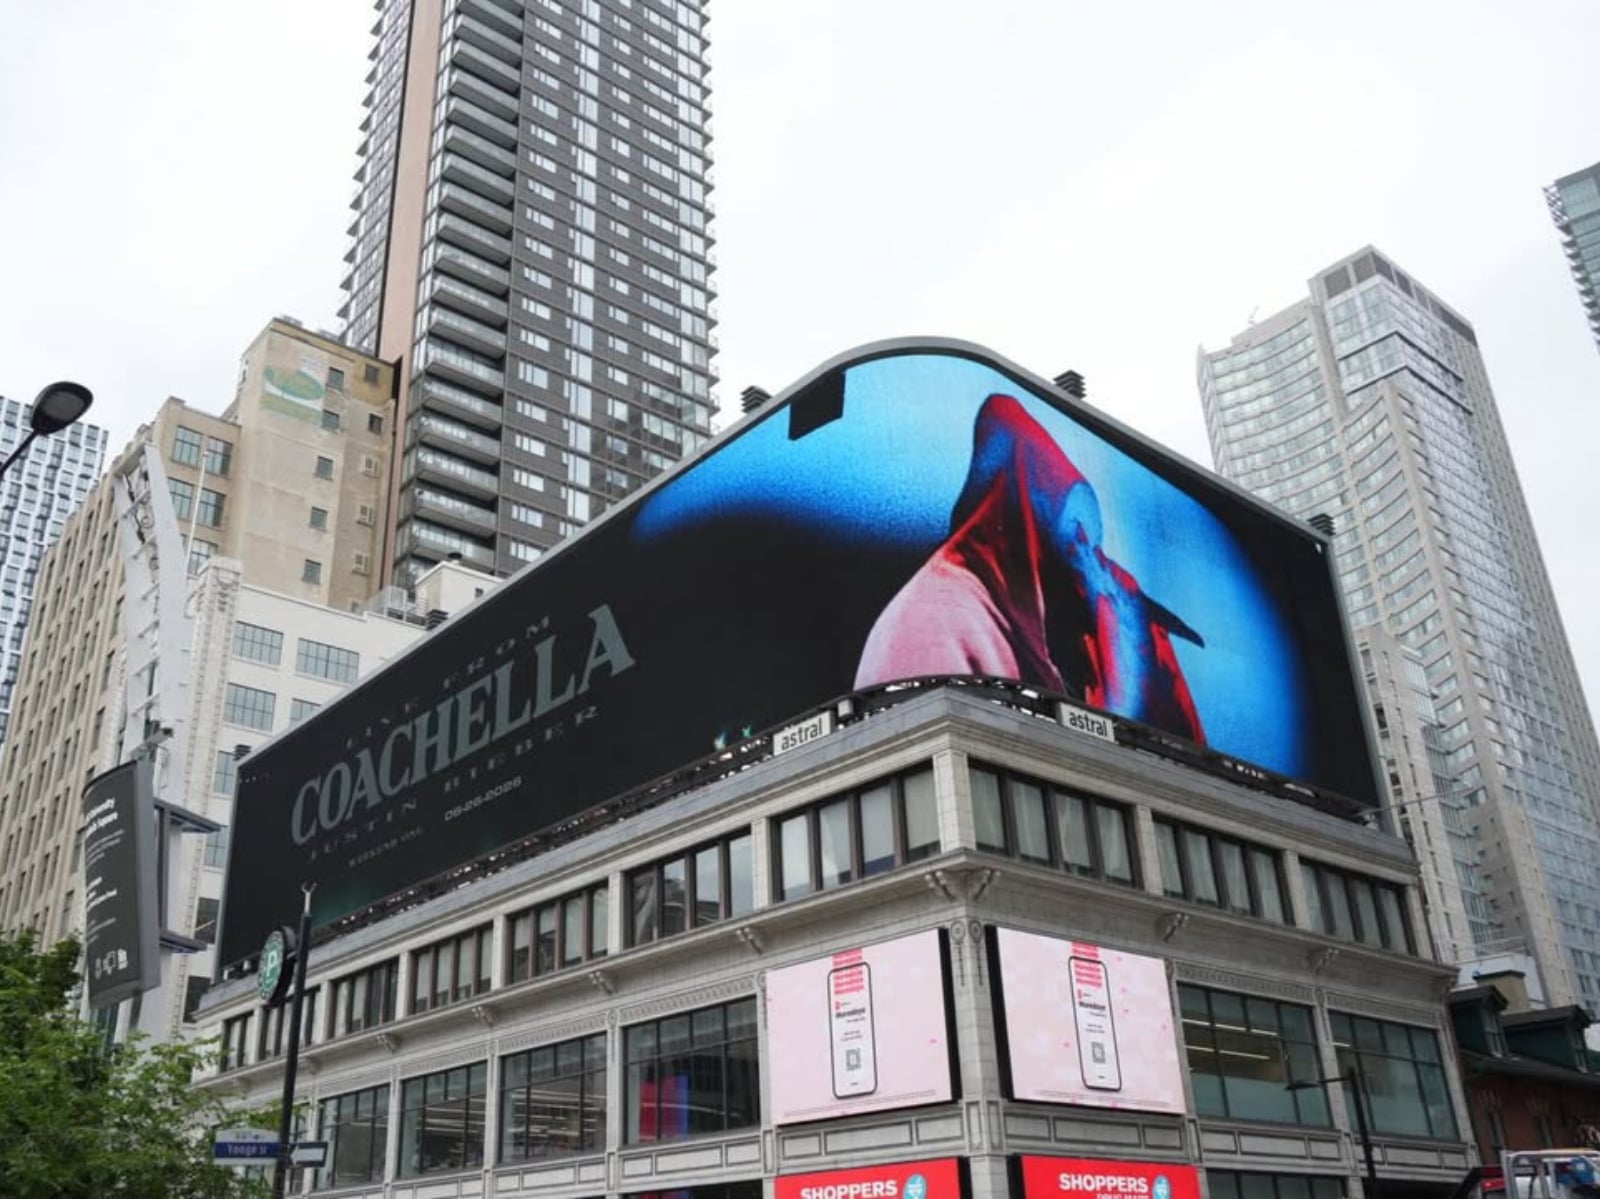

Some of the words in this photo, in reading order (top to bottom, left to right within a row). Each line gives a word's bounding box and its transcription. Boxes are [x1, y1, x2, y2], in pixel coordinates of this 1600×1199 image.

[291, 604, 636, 846] COACHELLA
[781, 717, 824, 750] astral
[1069, 711, 1108, 737] astral
[800, 1180, 898, 1199] SHOPPERS
[1059, 1172, 1149, 1193] SHOPPERS
